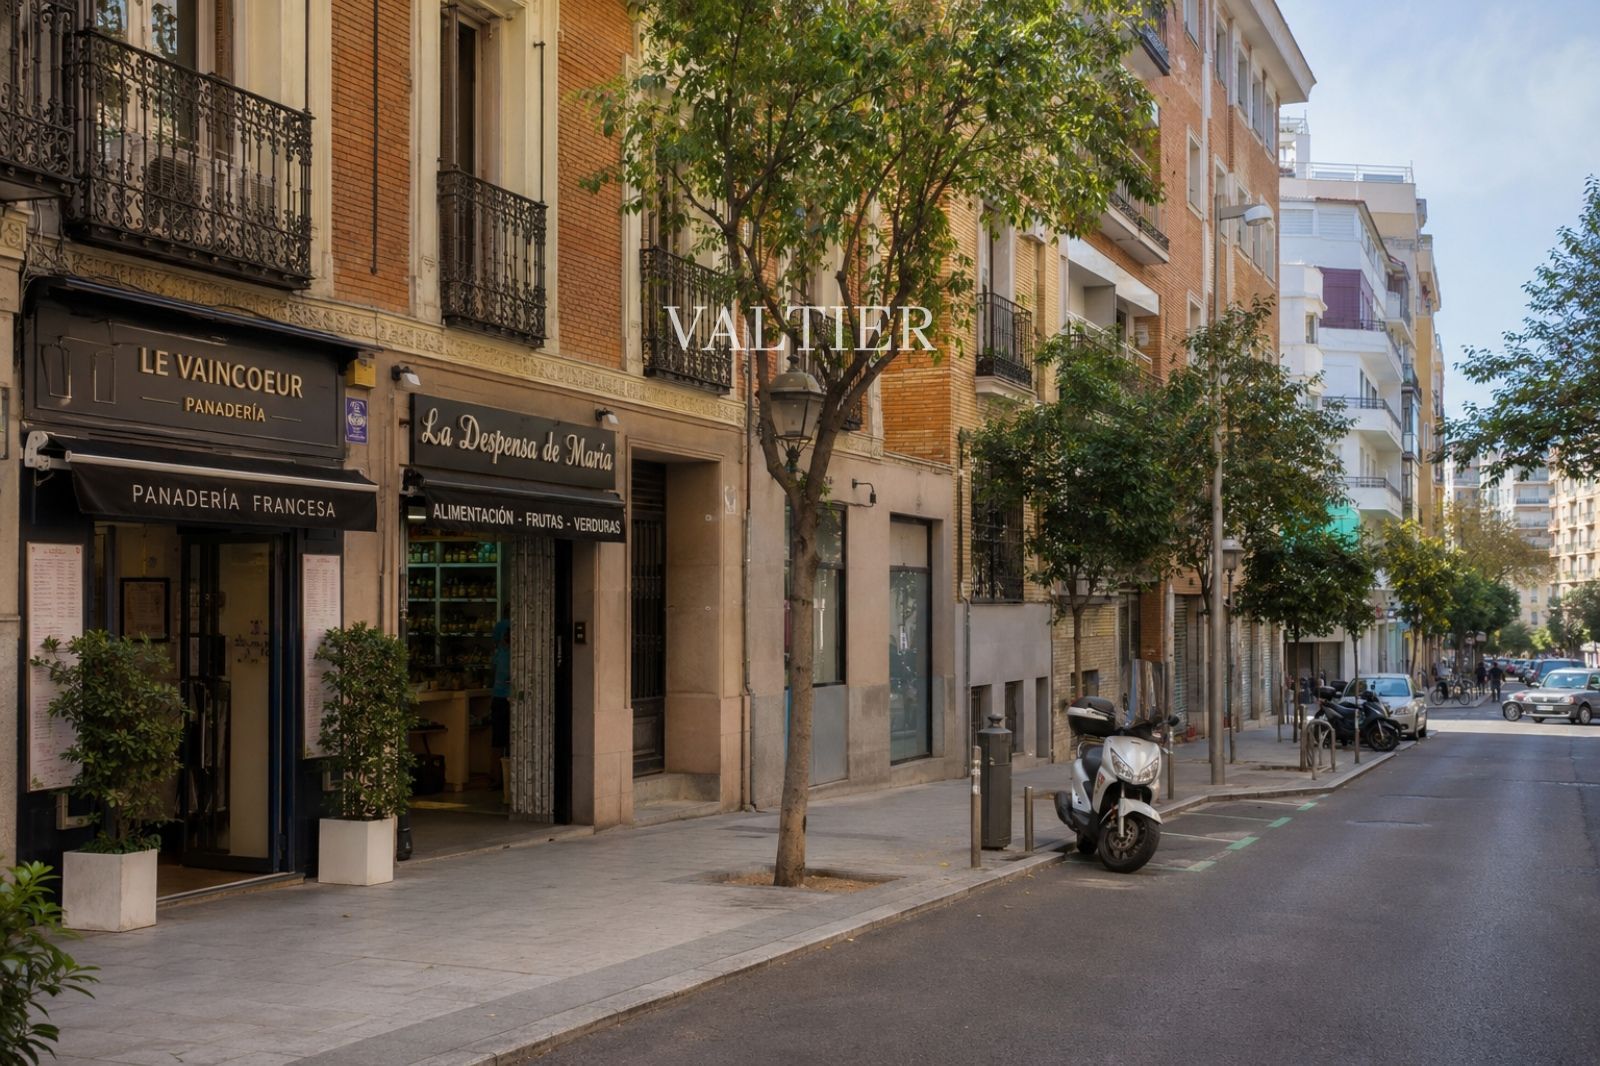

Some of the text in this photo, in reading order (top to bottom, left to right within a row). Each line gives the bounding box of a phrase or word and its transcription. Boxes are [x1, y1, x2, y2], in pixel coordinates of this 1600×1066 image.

[139, 347, 303, 398] LE VAINCOEUR
[185, 396, 266, 422] PANADERÍA
[420, 407, 613, 471] La Despensa de María
[132, 483, 336, 518] PANADERÍA FRANCESA
[433, 503, 514, 525] ALIMENTACIÓN
[526, 512, 563, 530] FRUTAS
[574, 517, 621, 535] VERDURAS
